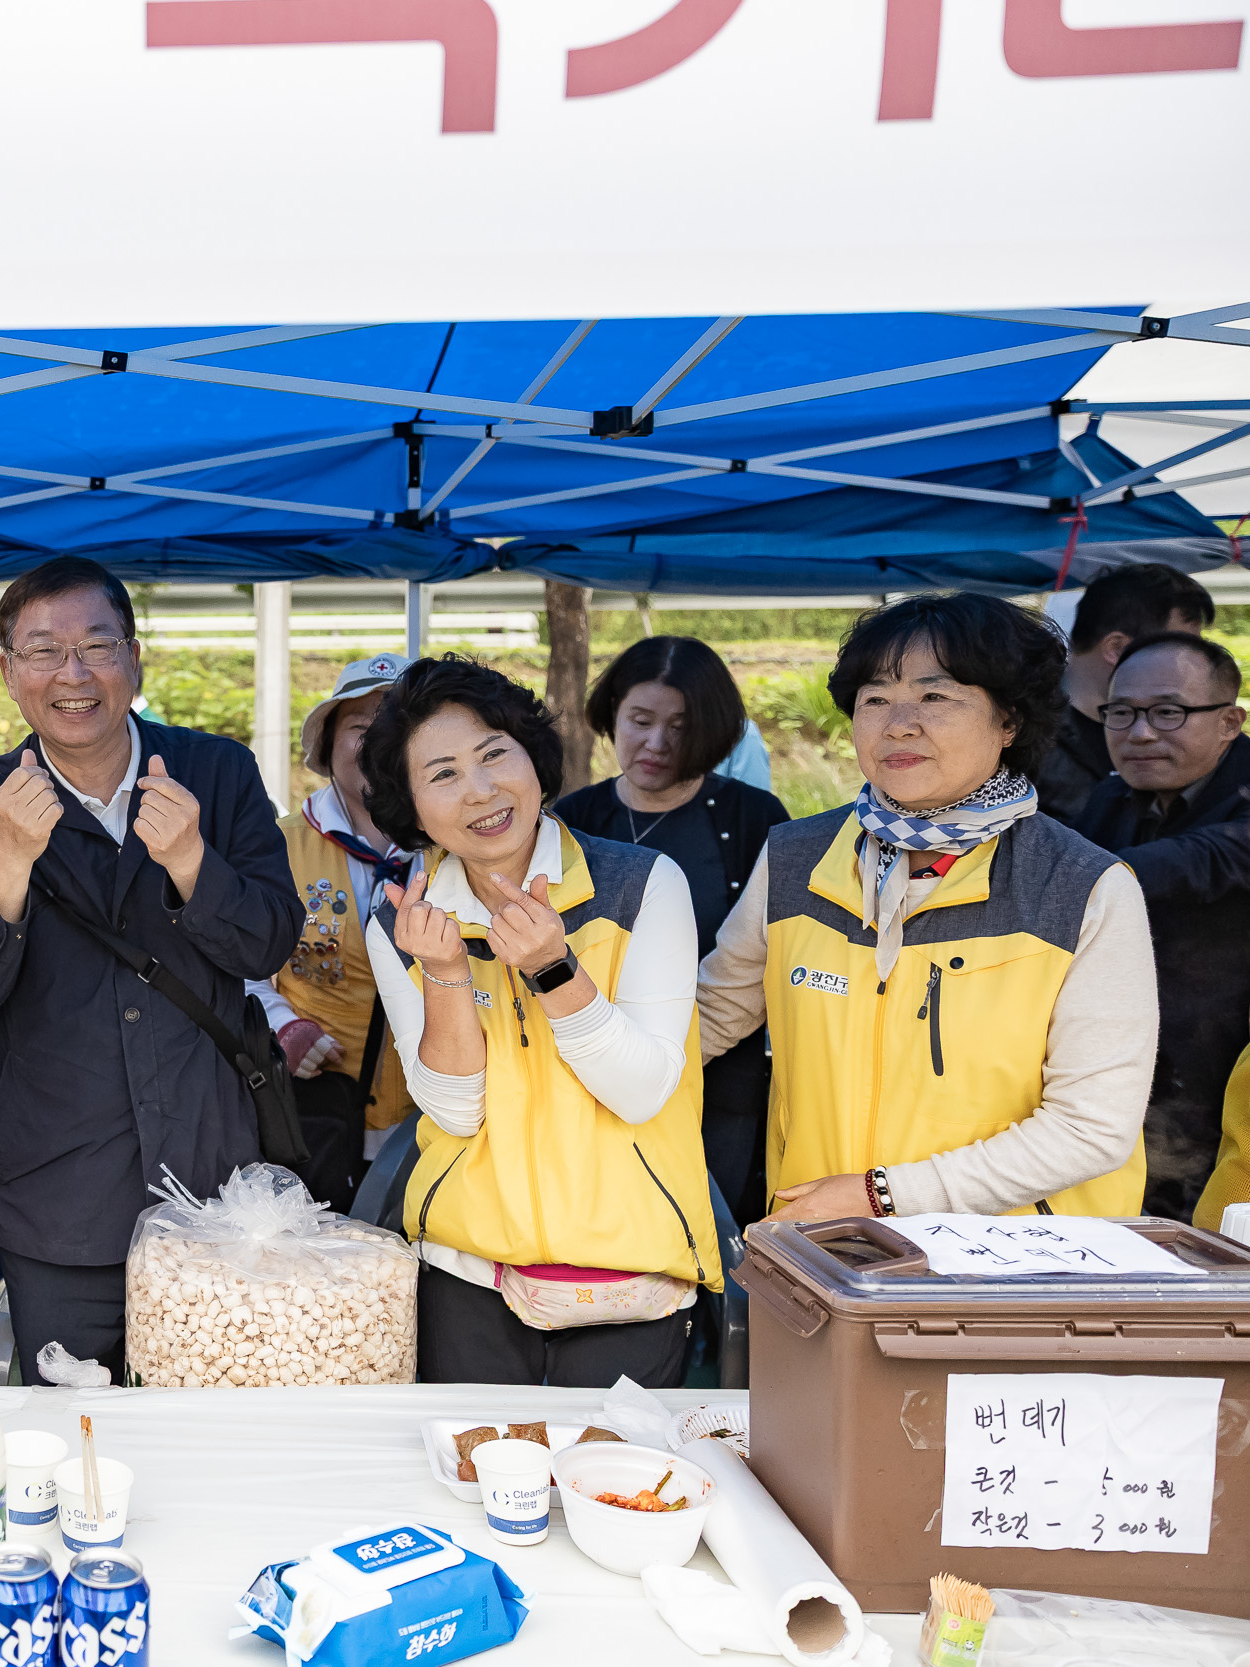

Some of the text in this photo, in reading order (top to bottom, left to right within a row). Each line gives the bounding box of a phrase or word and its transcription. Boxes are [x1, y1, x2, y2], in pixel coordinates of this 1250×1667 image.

[810, 971, 848, 988] 광진구
[971, 1465, 1016, 1494] 큰것
[513, 1483, 549, 1499] Cleanlab
[514, 1500, 537, 1510] 크린랩
[74, 1521, 98, 1532] 크린랩
[971, 1506, 1030, 1540] 작은것
